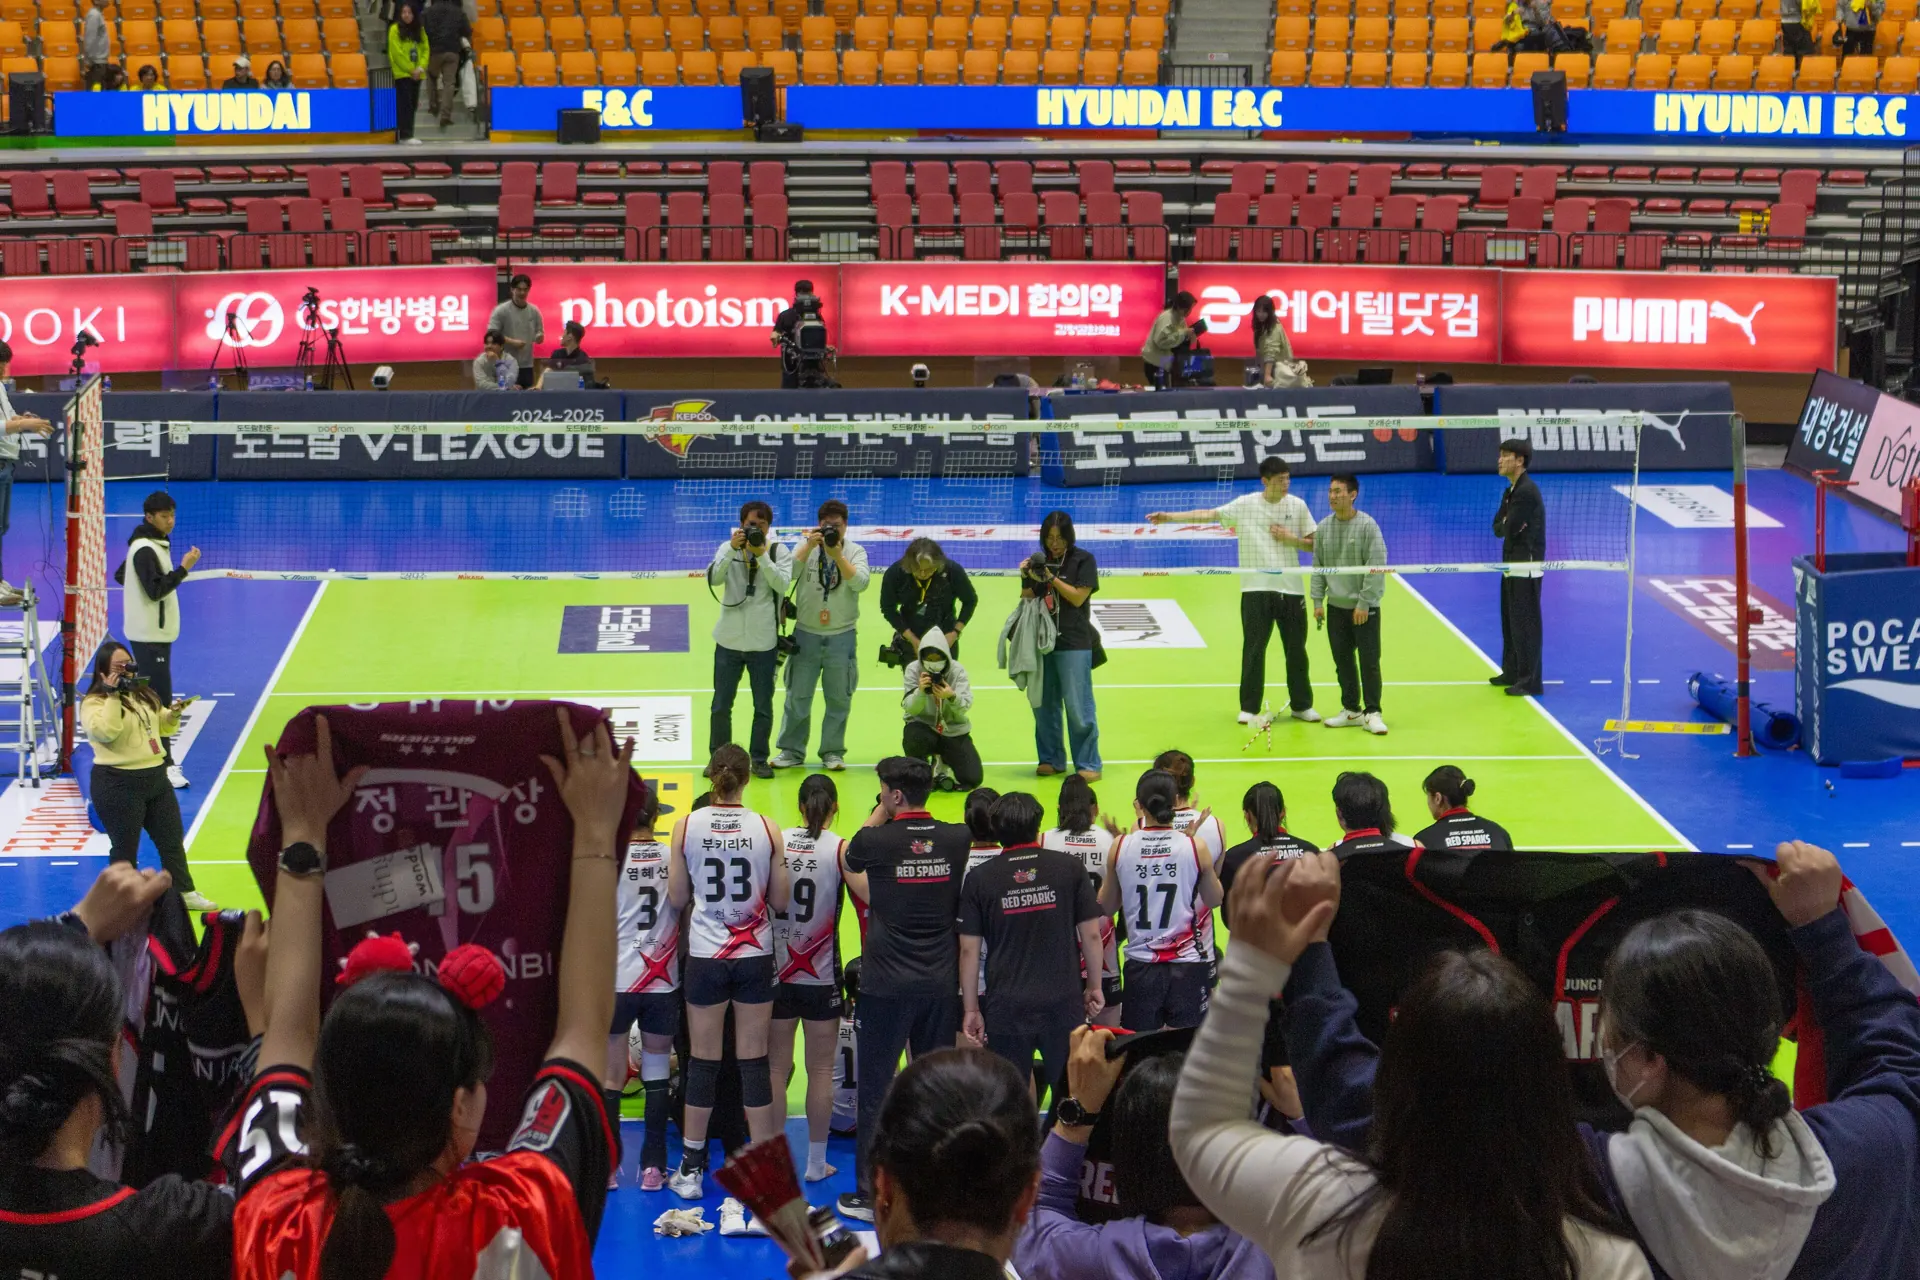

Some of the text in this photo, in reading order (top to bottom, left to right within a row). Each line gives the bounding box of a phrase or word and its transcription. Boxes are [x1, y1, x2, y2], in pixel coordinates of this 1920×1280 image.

[142, 93, 311, 132] HYUNDAI
[582, 90, 653, 126] E&C
[1037, 89, 1283, 127] HYUNDAI E&C
[1653, 94, 1907, 136] HYUNDAI E&C
[561, 282, 790, 331] photoism
[880, 283, 1123, 318] K-MEDI 한의약
[1263, 289, 1479, 338] 에어텔닷컴
[1572, 297, 1708, 344] PUMA
[511, 409, 605, 422] 2024~2025
[676, 412, 712, 421] KEPCO
[1497, 408, 1638, 451] PUMA
[1801, 396, 1868, 465] 대방건설
[357, 430, 605, 461] V-LEAGUE
[1070, 404, 1367, 470] 도드람한돈
[1826, 644, 1920, 675] SWE
[702, 837, 753, 851] 부키리치
[710, 822, 742, 831] RED SPARKS
[1445, 833, 1491, 847] RED SPARKS
[1063, 851, 1102, 866] 혜민
[1152, 846, 1172, 855] SPARKS
[626, 866, 668, 881] 염혜선
[704, 857, 752, 903] 33
[896, 864, 951, 878] RED SPARKS
[1135, 863, 1177, 879] 정호영
[637, 886, 659, 931] 3
[775, 878, 817, 923] 9
[1002, 890, 1057, 909] RED SPARKS
[1135, 883, 1178, 930] 17
[1564, 977, 1598, 991] JUNG
[1081, 1160, 1120, 1205] RE
